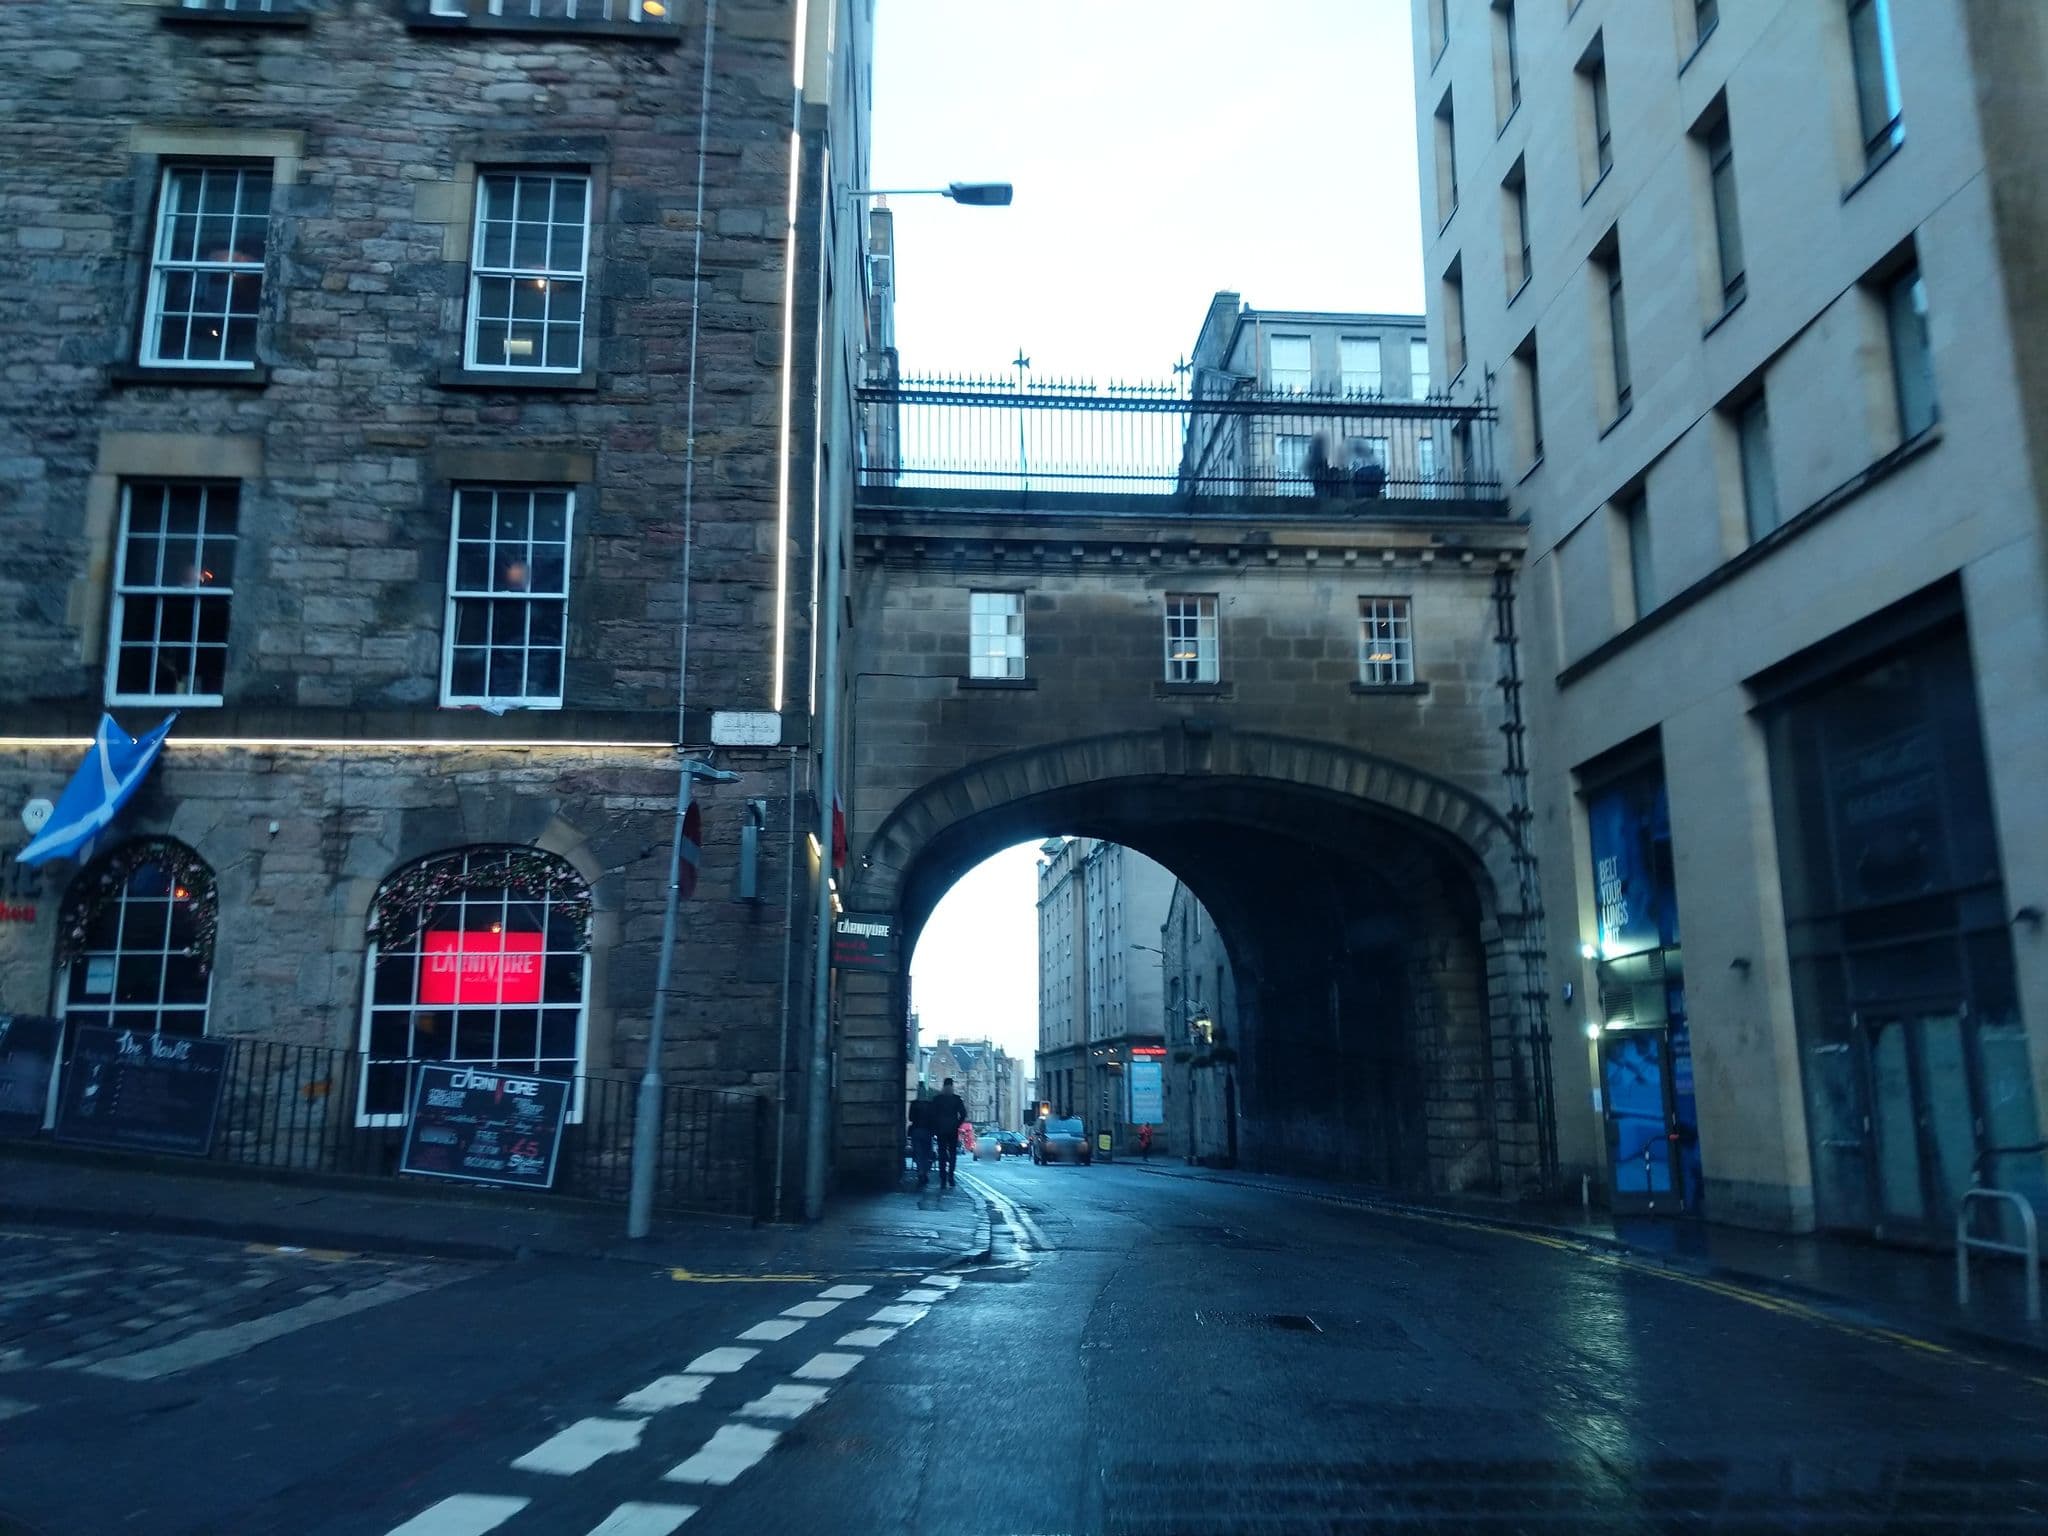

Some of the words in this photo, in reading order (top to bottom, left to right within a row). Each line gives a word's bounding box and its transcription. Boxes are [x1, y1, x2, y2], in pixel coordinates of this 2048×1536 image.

[1600, 856, 1617, 881] BELT
[1601, 879, 1622, 905] YOUR
[837, 917, 890, 939] CARNIVORE
[1603, 901, 1628, 929] LUNGS
[431, 943, 534, 979] CARNIVORE
[115, 1029, 144, 1055] The
[150, 1031, 192, 1060] Vault
[450, 1065, 540, 1105] CARNIVORE
